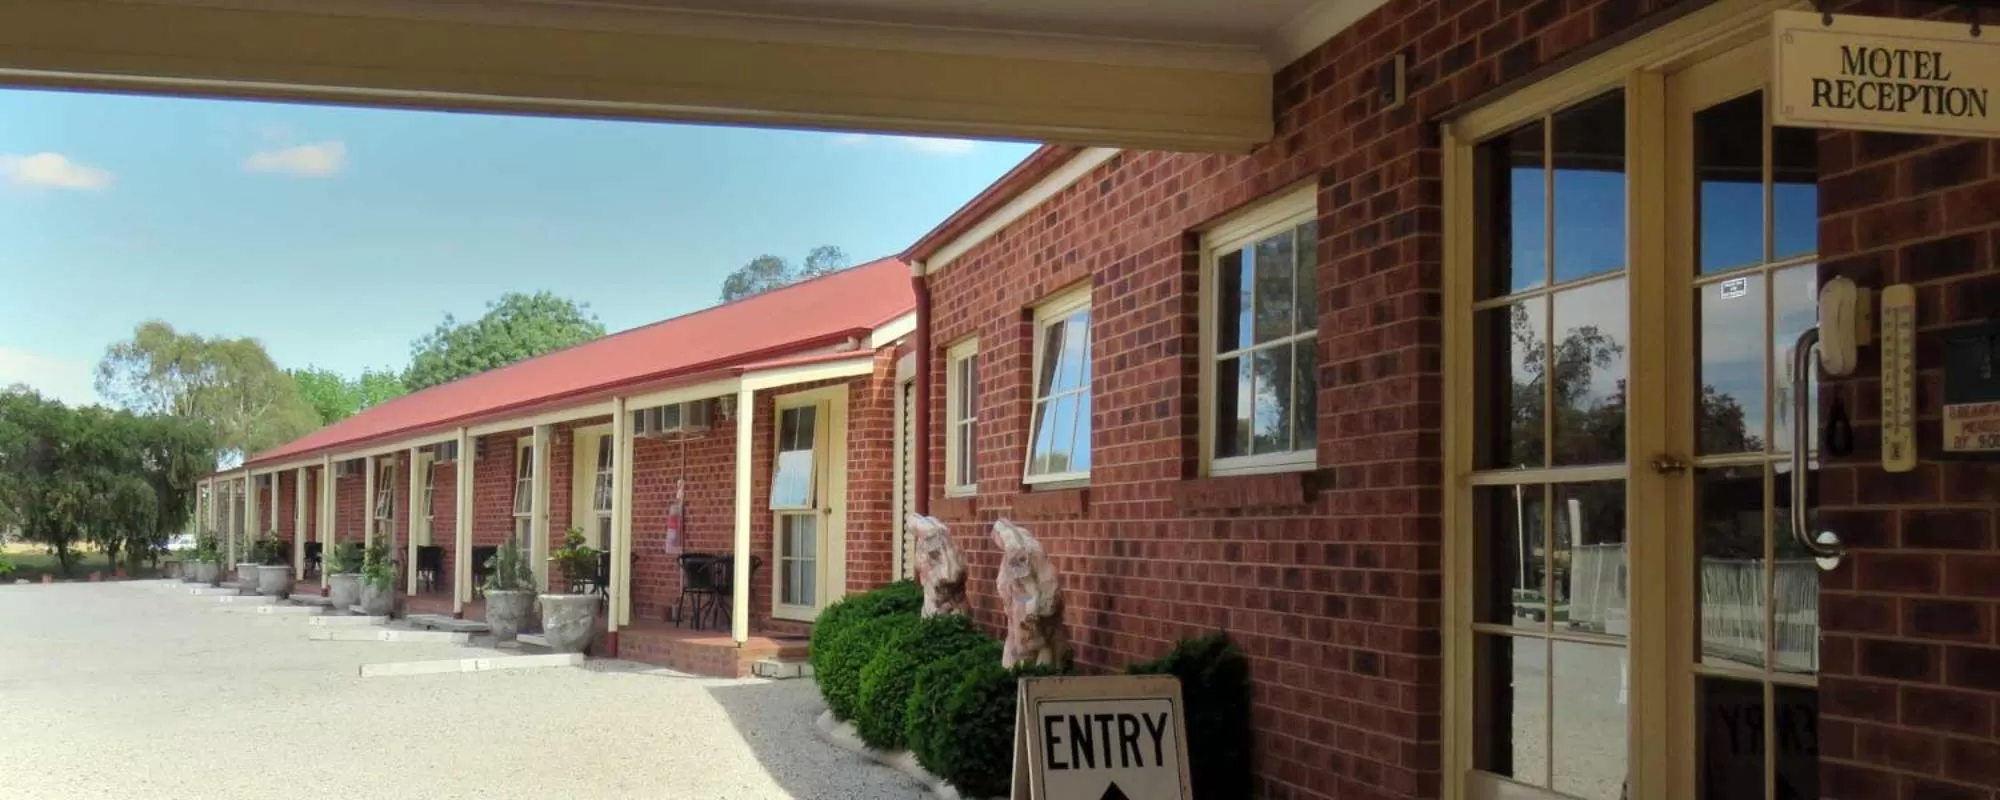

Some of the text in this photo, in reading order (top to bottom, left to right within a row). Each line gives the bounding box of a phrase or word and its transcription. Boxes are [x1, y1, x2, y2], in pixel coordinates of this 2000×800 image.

[1840, 45, 1951, 82] MOTEL
[1811, 78, 1988, 118] RECEPTION
[1044, 712, 1168, 770] ENTRY
